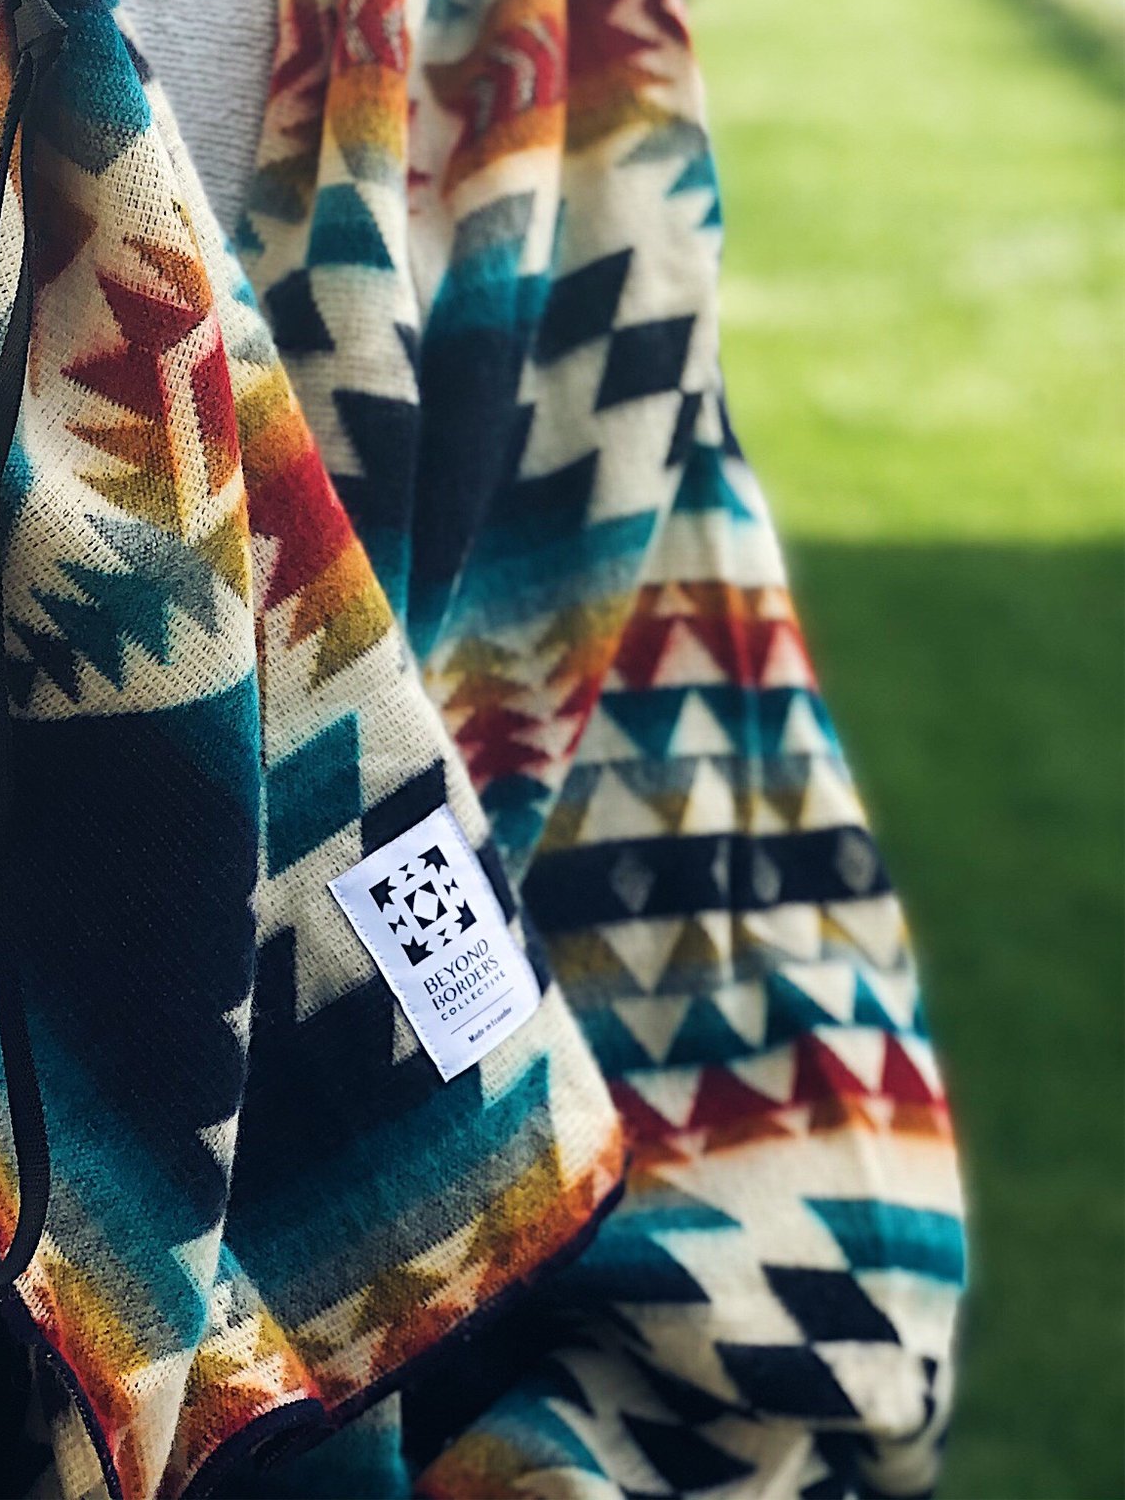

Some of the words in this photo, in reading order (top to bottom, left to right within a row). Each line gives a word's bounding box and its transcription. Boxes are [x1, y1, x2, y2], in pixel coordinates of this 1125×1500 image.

[423, 939, 488, 995] BEYOND
[431, 955, 499, 1011] BORDERS
[441, 970, 506, 1021] COLLECTIVE
